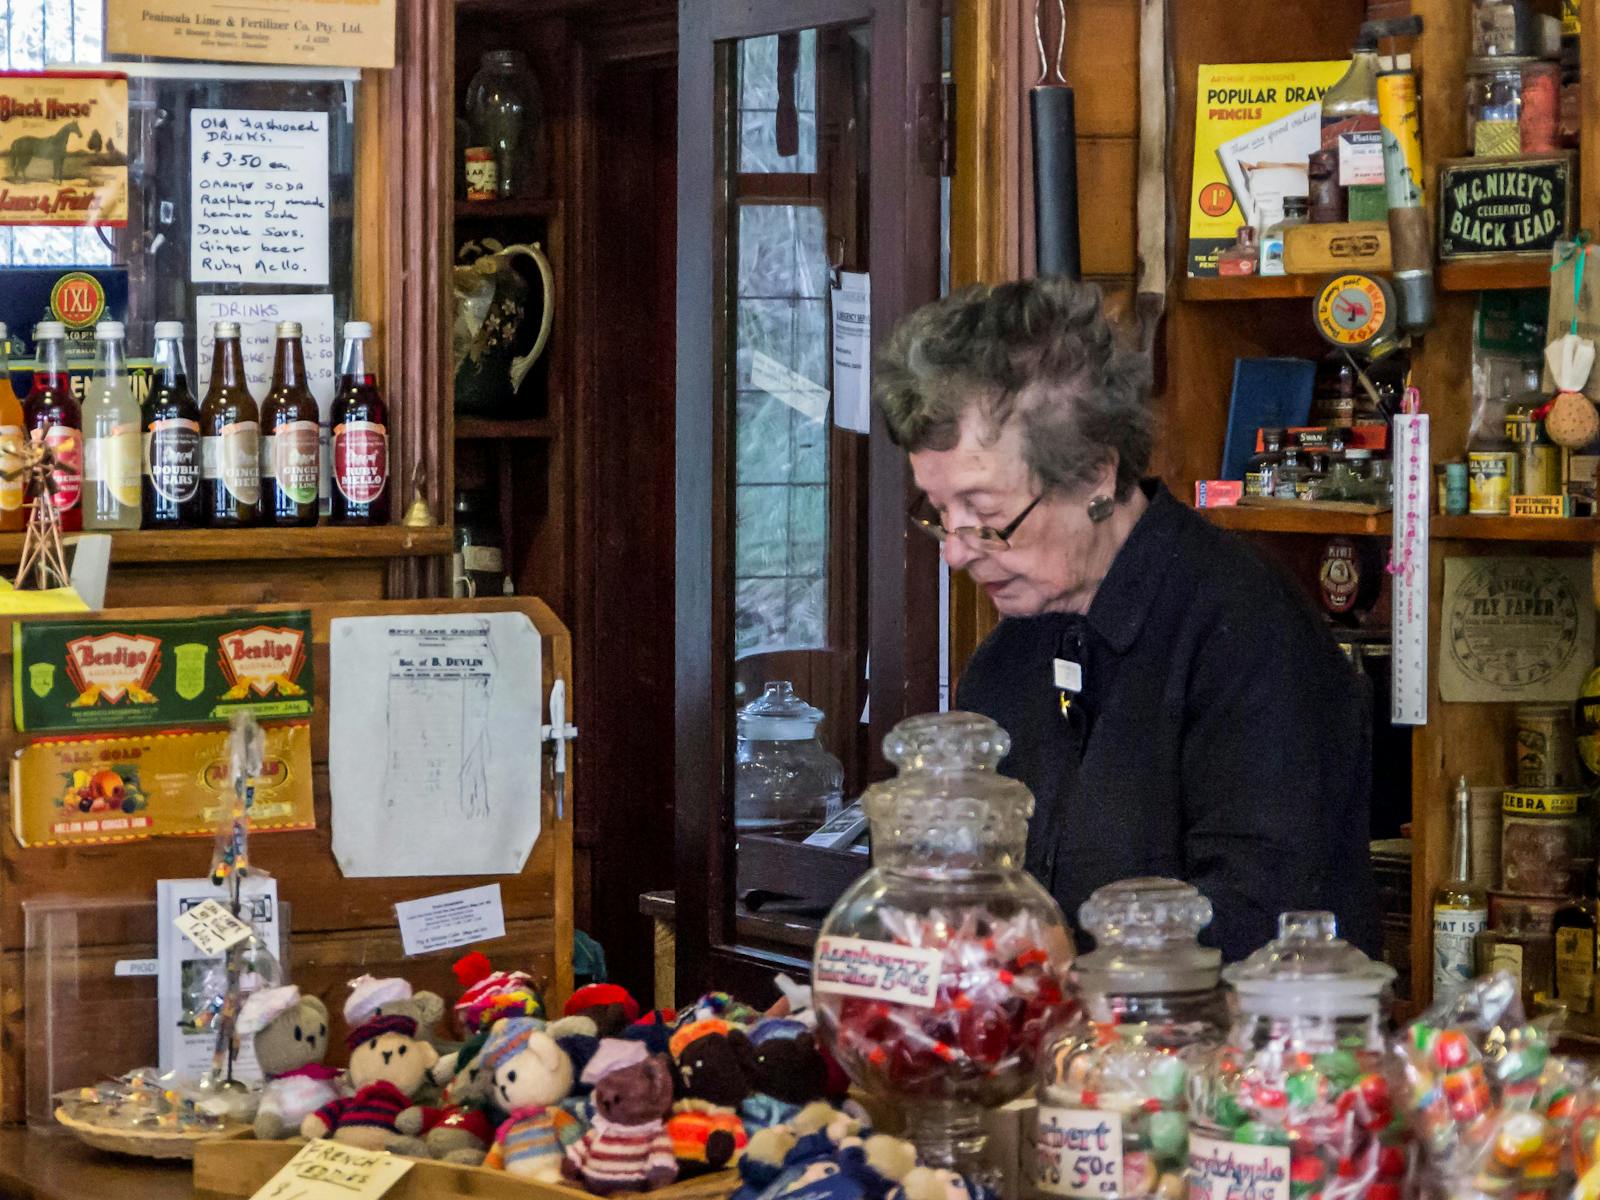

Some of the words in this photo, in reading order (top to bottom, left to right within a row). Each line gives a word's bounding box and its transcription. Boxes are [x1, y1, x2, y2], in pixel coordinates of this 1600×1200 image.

[142, 10, 190, 23] Peninsula
[195, 14, 221, 26] Lime
[226, 17, 234, 27] &
[241, 17, 289, 30] Fertilizer
[342, 23, 362, 34] Ltd.
[1207, 88, 1277, 105] POPULAR
[1285, 86, 1331, 103] DRAW
[1208, 107, 1263, 120] PENCILS
[201, 118, 228, 130] Old
[265, 182, 304, 191] SODA
[1477, 203, 1531, 217] CELEBRATED
[1450, 210, 1507, 247] BLACK
[199, 241, 251, 254] Ginger
[261, 243, 305, 253] beer
[202, 257, 242, 275] Ruby
[63, 287, 93, 312] IXL
[209, 302, 280, 318] DRINKS
[1300, 432, 1323, 442] SWAN
[153, 465, 199, 475] DOUBLE
[346, 466, 379, 476] RUBY
[163, 475, 193, 485] SARS
[341, 475, 382, 485] MELLO
[1515, 505, 1560, 515] PELLETS
[1505, 598, 1554, 616] PAPER
[432, 657, 441, 667] B.
[446, 657, 483, 667] DEVLIN
[1504, 794, 1546, 812] ZEBRA
[1463, 922, 1475, 932] IS
